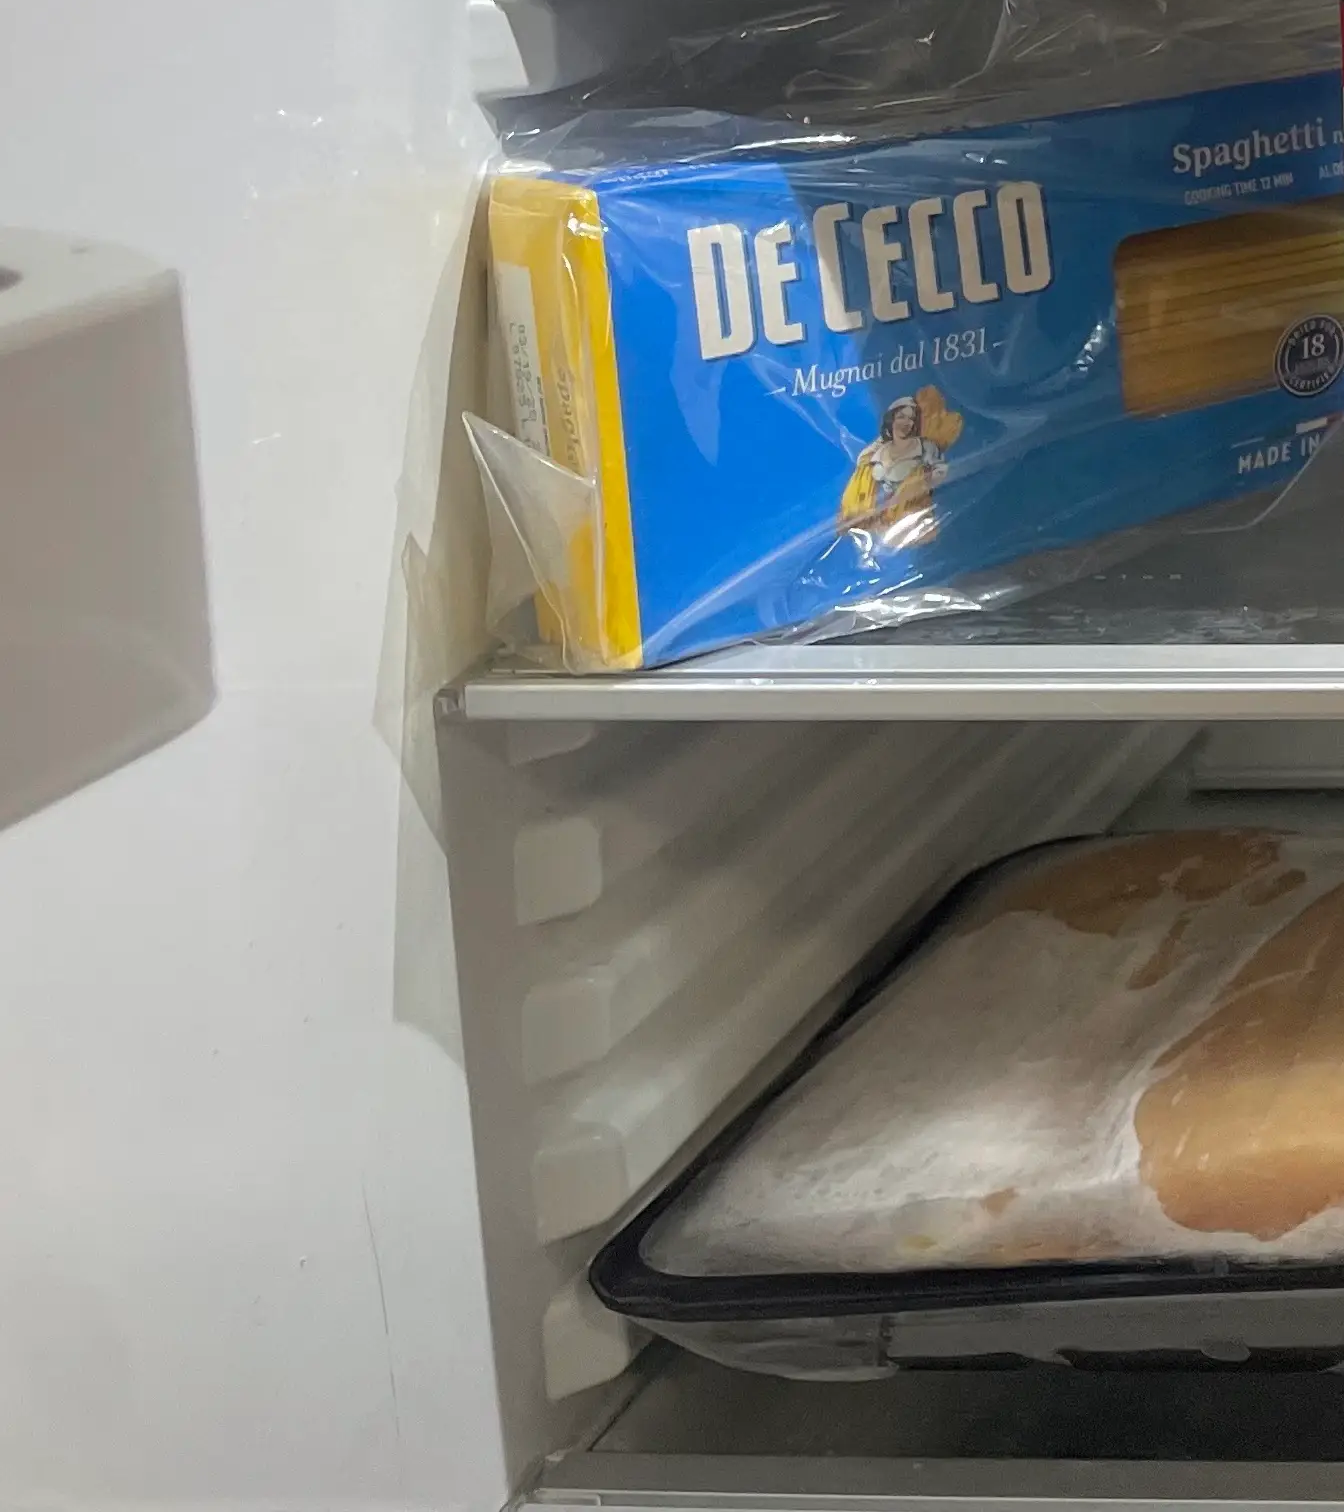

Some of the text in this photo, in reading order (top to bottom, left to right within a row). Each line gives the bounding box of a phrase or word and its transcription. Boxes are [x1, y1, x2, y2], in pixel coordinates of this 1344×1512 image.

[1171, 117, 1327, 178] Spaghetti
[790, 328, 989, 399] Mugnai dal 1831
[1237, 442, 1292, 474] MADE
